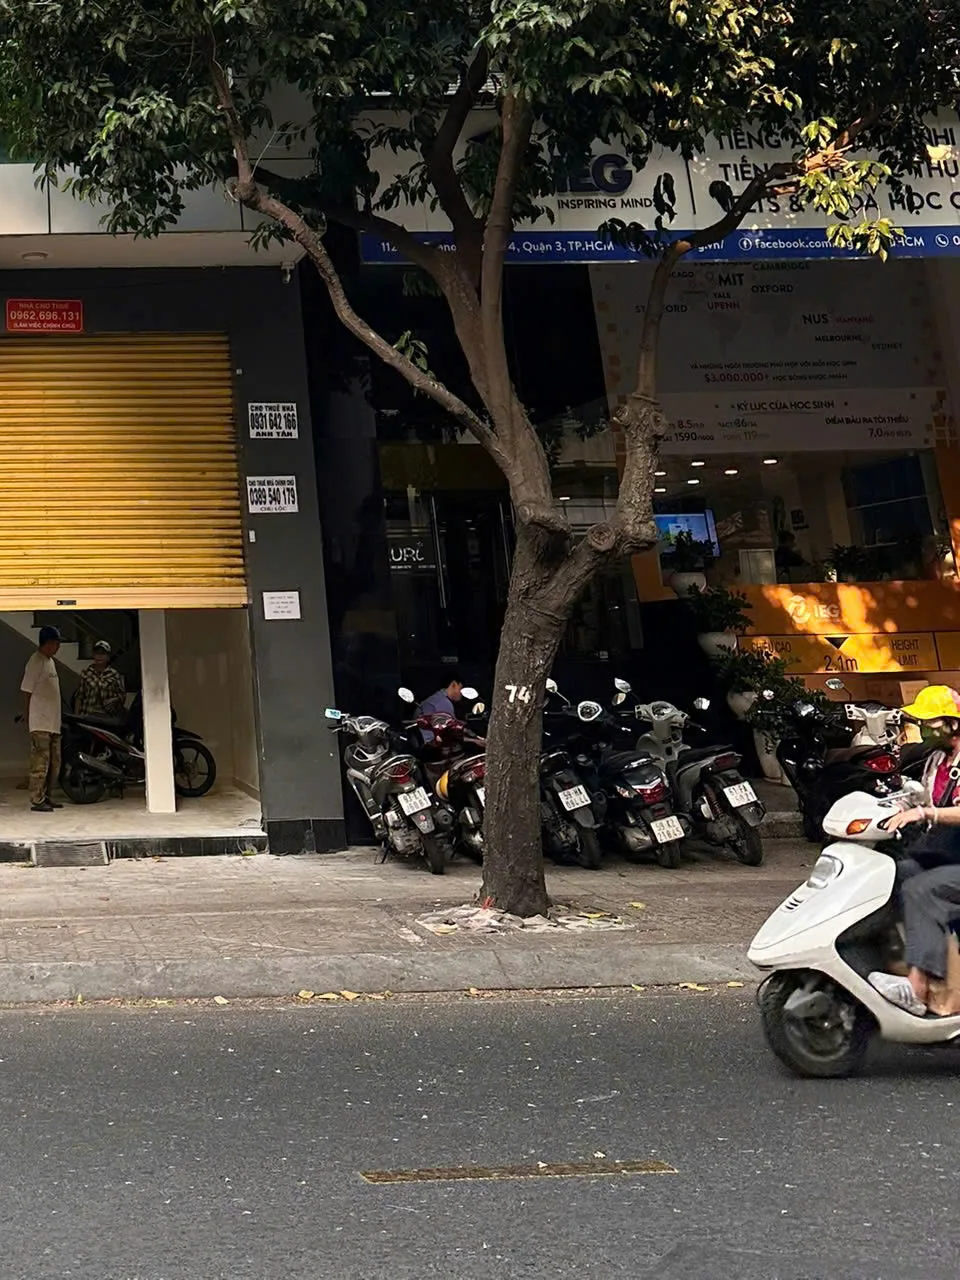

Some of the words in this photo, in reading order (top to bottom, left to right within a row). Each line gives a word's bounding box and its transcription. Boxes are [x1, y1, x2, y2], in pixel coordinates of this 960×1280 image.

[557, 198, 617, 210] INSPIRING
[620, 197, 657, 209] MIND
[522, 240, 545, 253] Quận
[718, 272, 745, 287] MIT
[751, 283, 795, 294] OXFORD
[9, 310, 80, 322] 0962.696.131
[802, 313, 829, 325] NUS
[250, 412, 267, 430] 0931
[268, 412, 282, 430] 642
[283, 412, 297, 430] 166
[282, 487, 296, 506] 179
[891, 638, 920, 651] HEIGHT
[823, 654, 859, 671] 2.1m
[504, 684, 531, 704] 74
